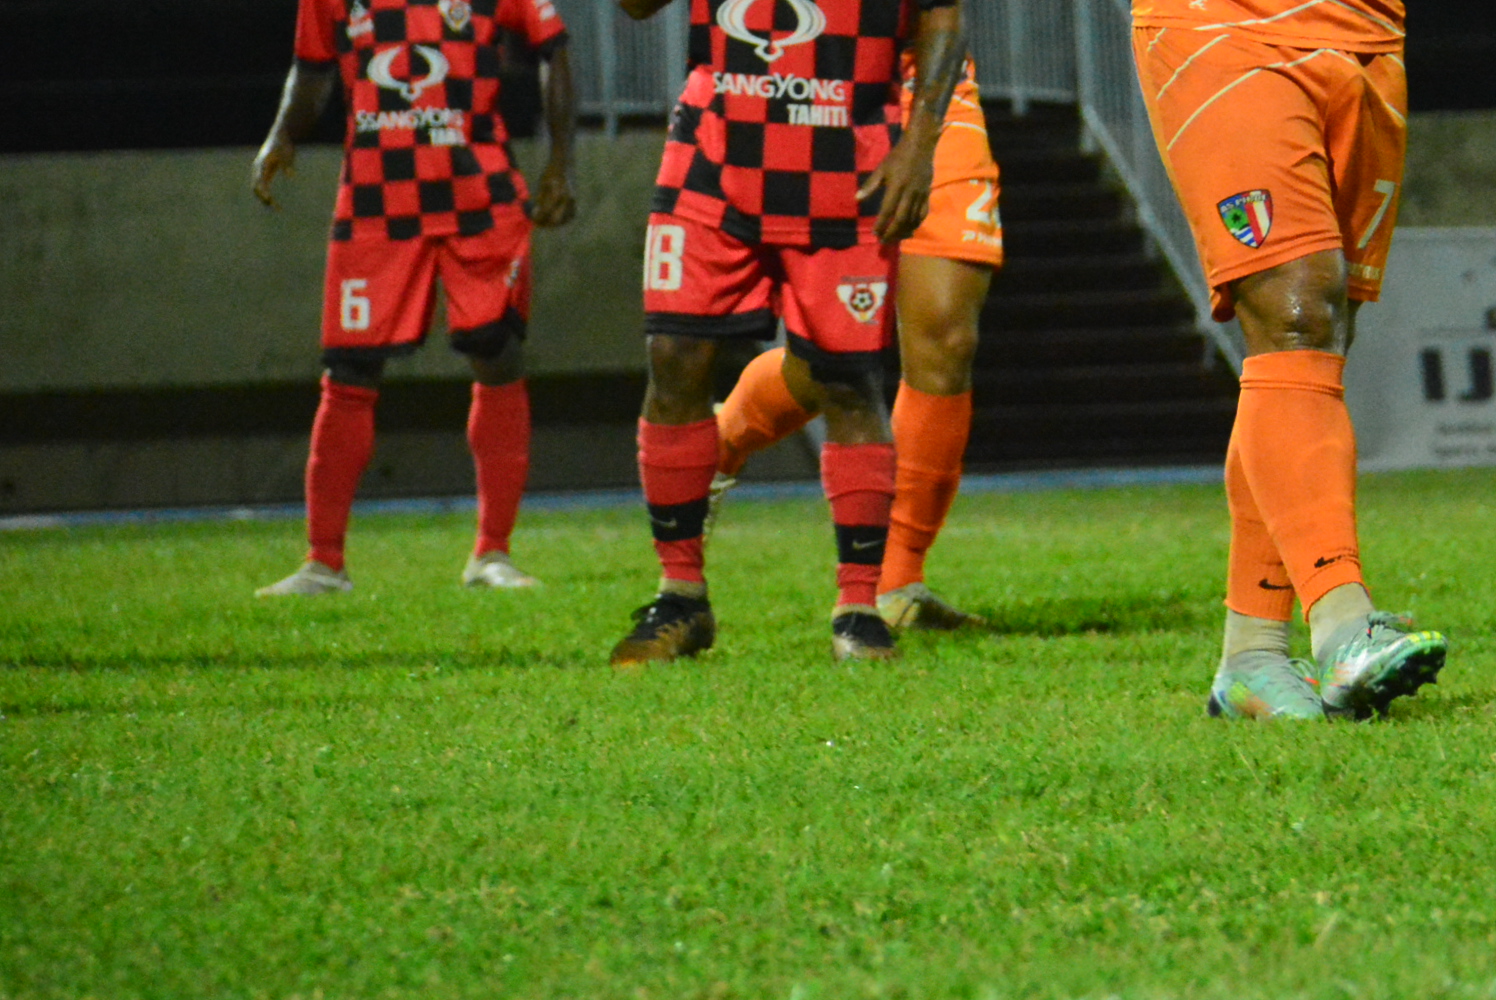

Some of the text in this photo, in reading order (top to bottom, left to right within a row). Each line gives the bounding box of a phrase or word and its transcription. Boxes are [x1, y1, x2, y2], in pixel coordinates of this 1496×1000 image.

[786, 103, 848, 127] TAHITI
[1356, 178, 1396, 249] 7
[340, 278, 371, 332] 6
